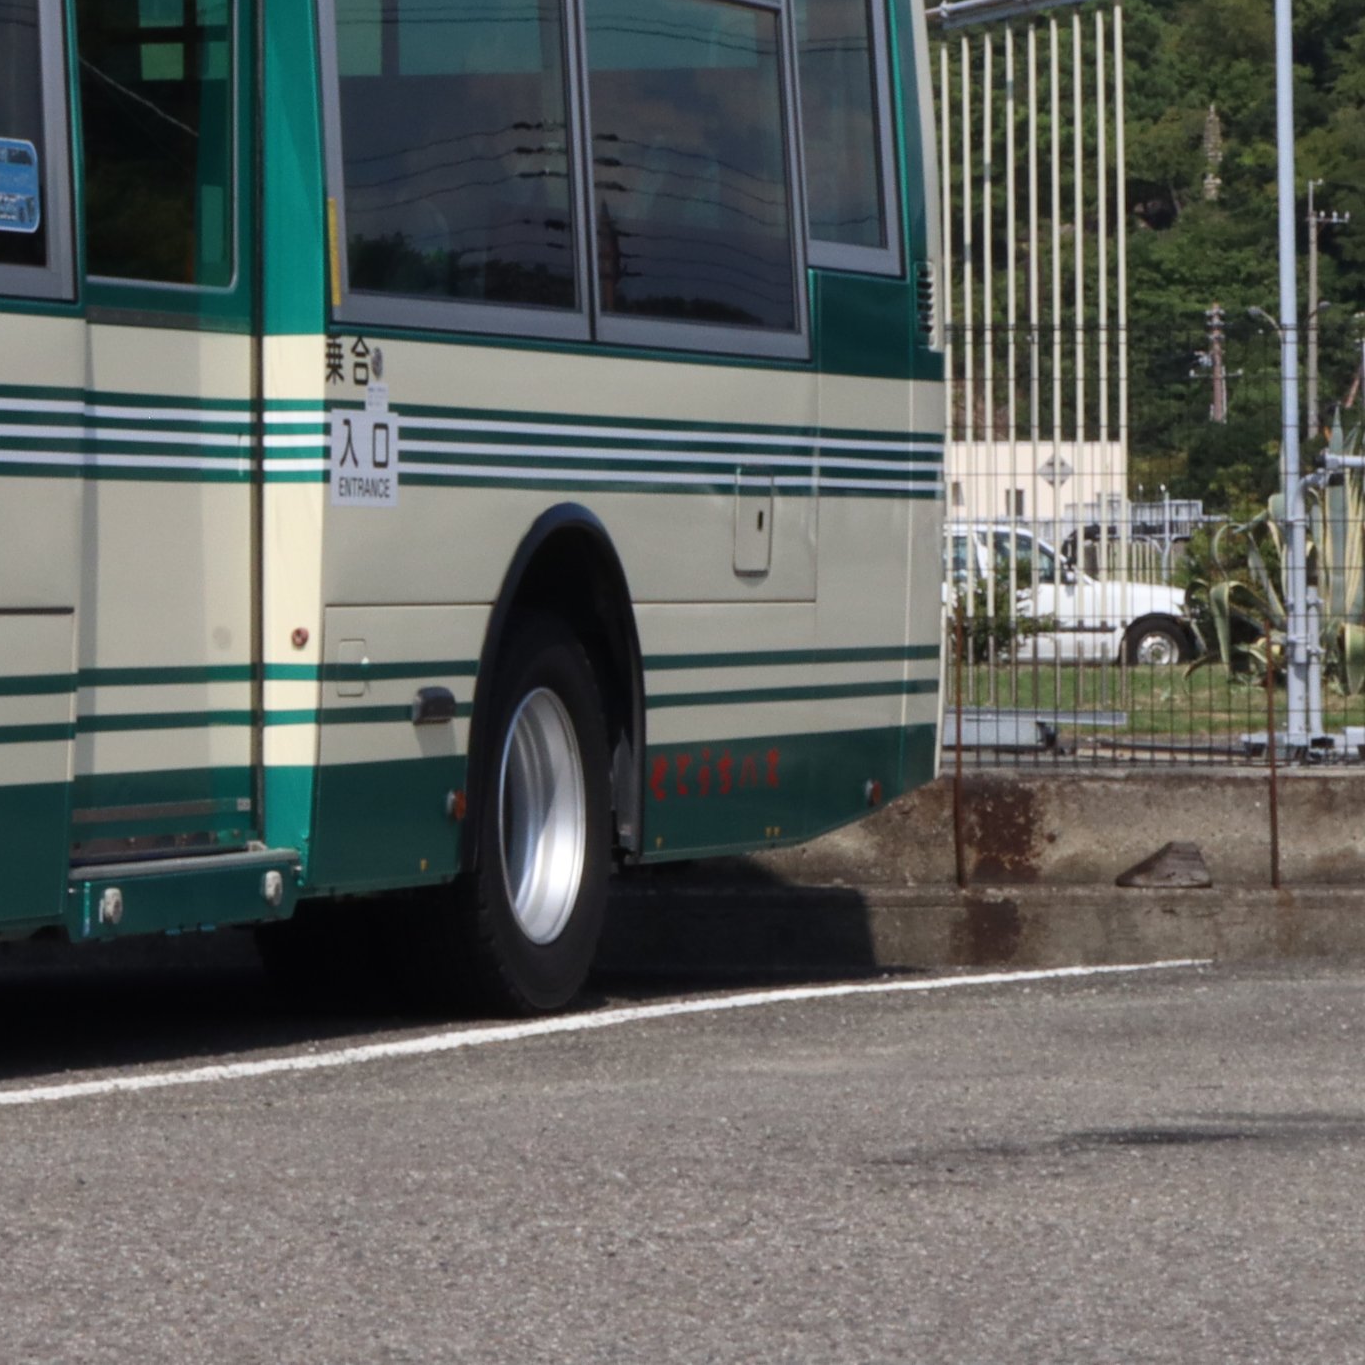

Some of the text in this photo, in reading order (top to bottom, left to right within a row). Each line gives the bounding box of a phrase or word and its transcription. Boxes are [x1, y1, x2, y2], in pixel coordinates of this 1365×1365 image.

[325, 333, 370, 385] 乗合
[339, 418, 390, 468] 入口
[339, 477, 390, 498] ENTRANCE
